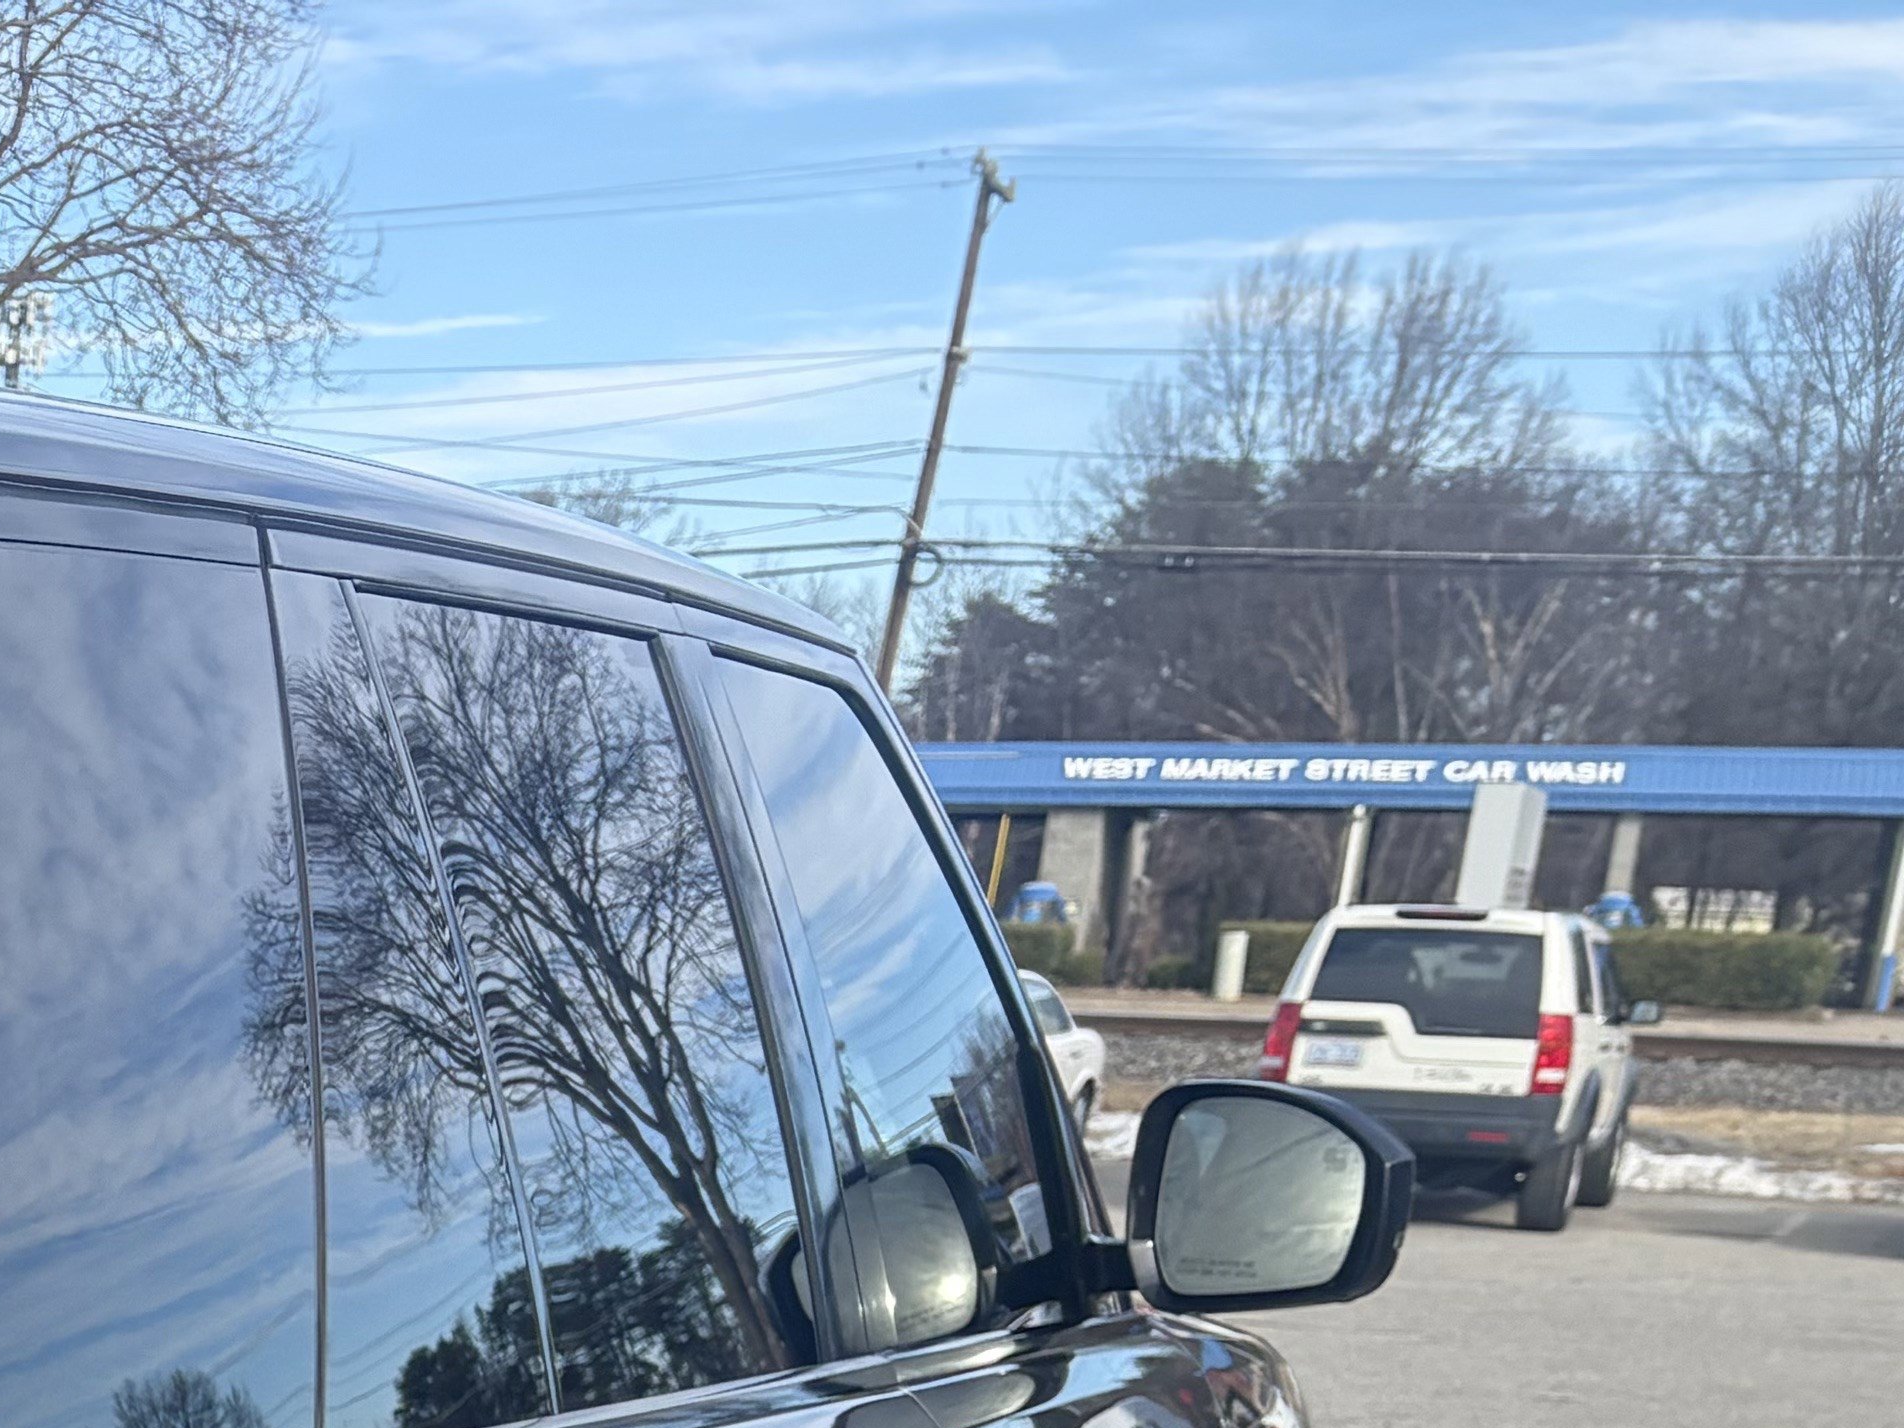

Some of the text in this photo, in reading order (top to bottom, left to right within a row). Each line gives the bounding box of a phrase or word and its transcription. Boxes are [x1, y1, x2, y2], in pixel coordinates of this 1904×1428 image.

[1064, 757, 1626, 784] WEST MARKET STREET CAR WASH
